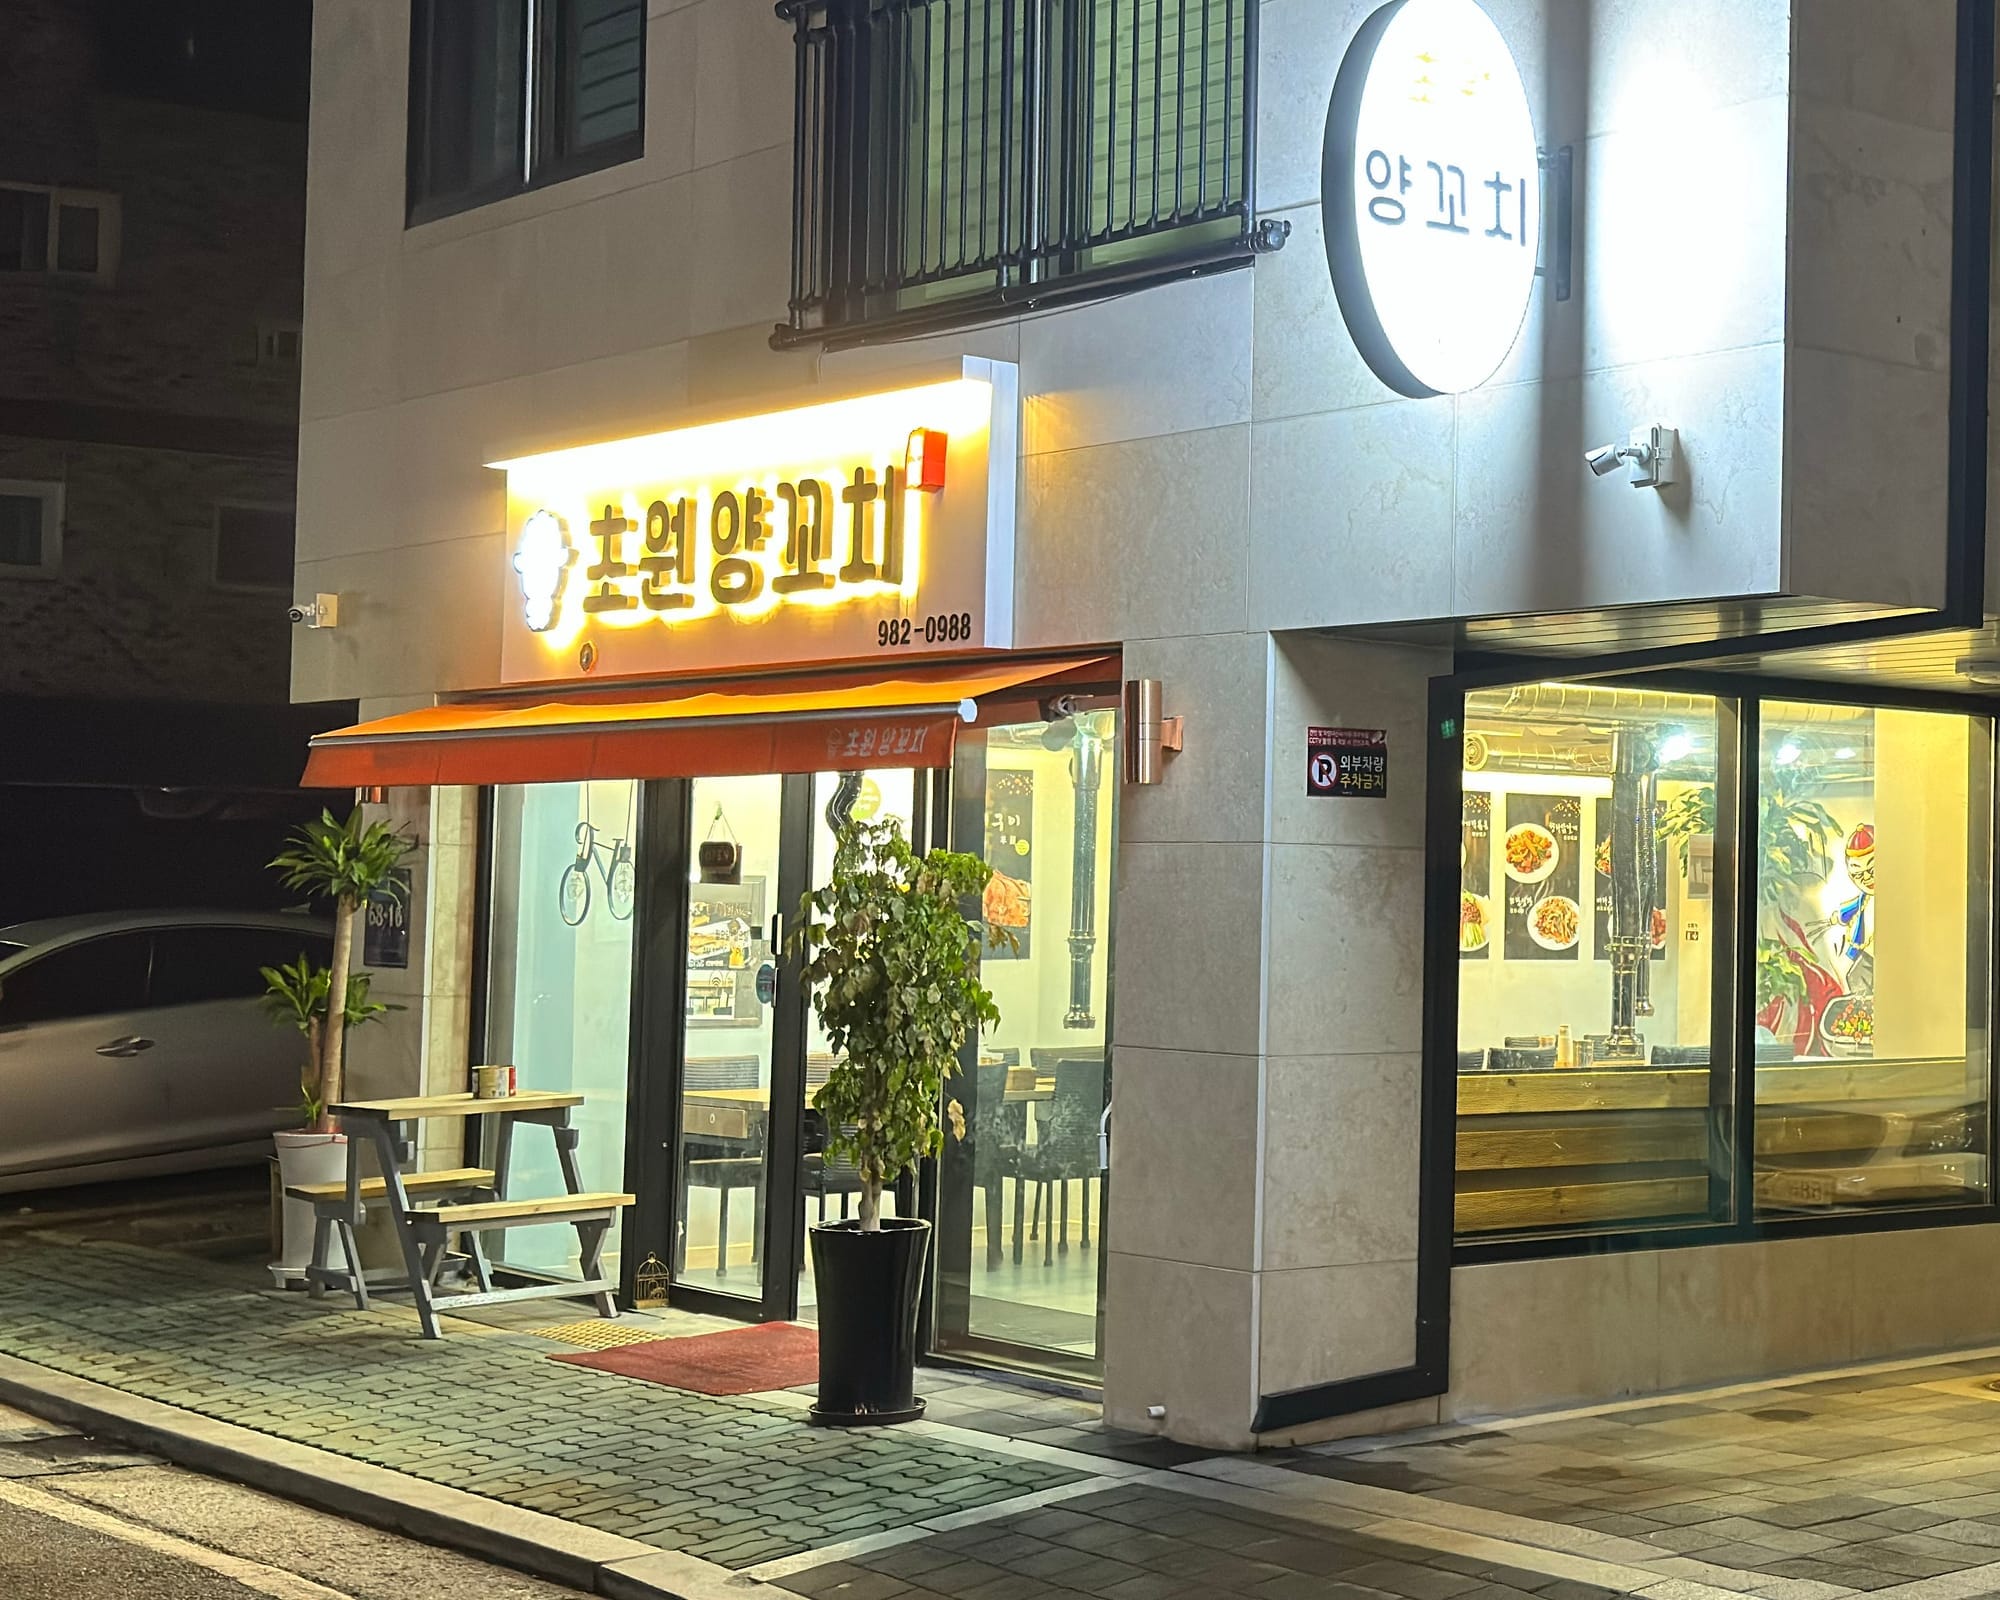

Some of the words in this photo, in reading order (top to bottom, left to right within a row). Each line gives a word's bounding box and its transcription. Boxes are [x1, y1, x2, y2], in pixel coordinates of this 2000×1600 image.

[1366, 149, 1526, 247] 양꼬치
[583, 496, 696, 613] 초원
[710, 464, 904, 605] 양꼬치
[877, 612, 972, 647] 982-0988
[1340, 755, 1384, 773] 외부차량
[1340, 773, 1384, 790] 주차금지
